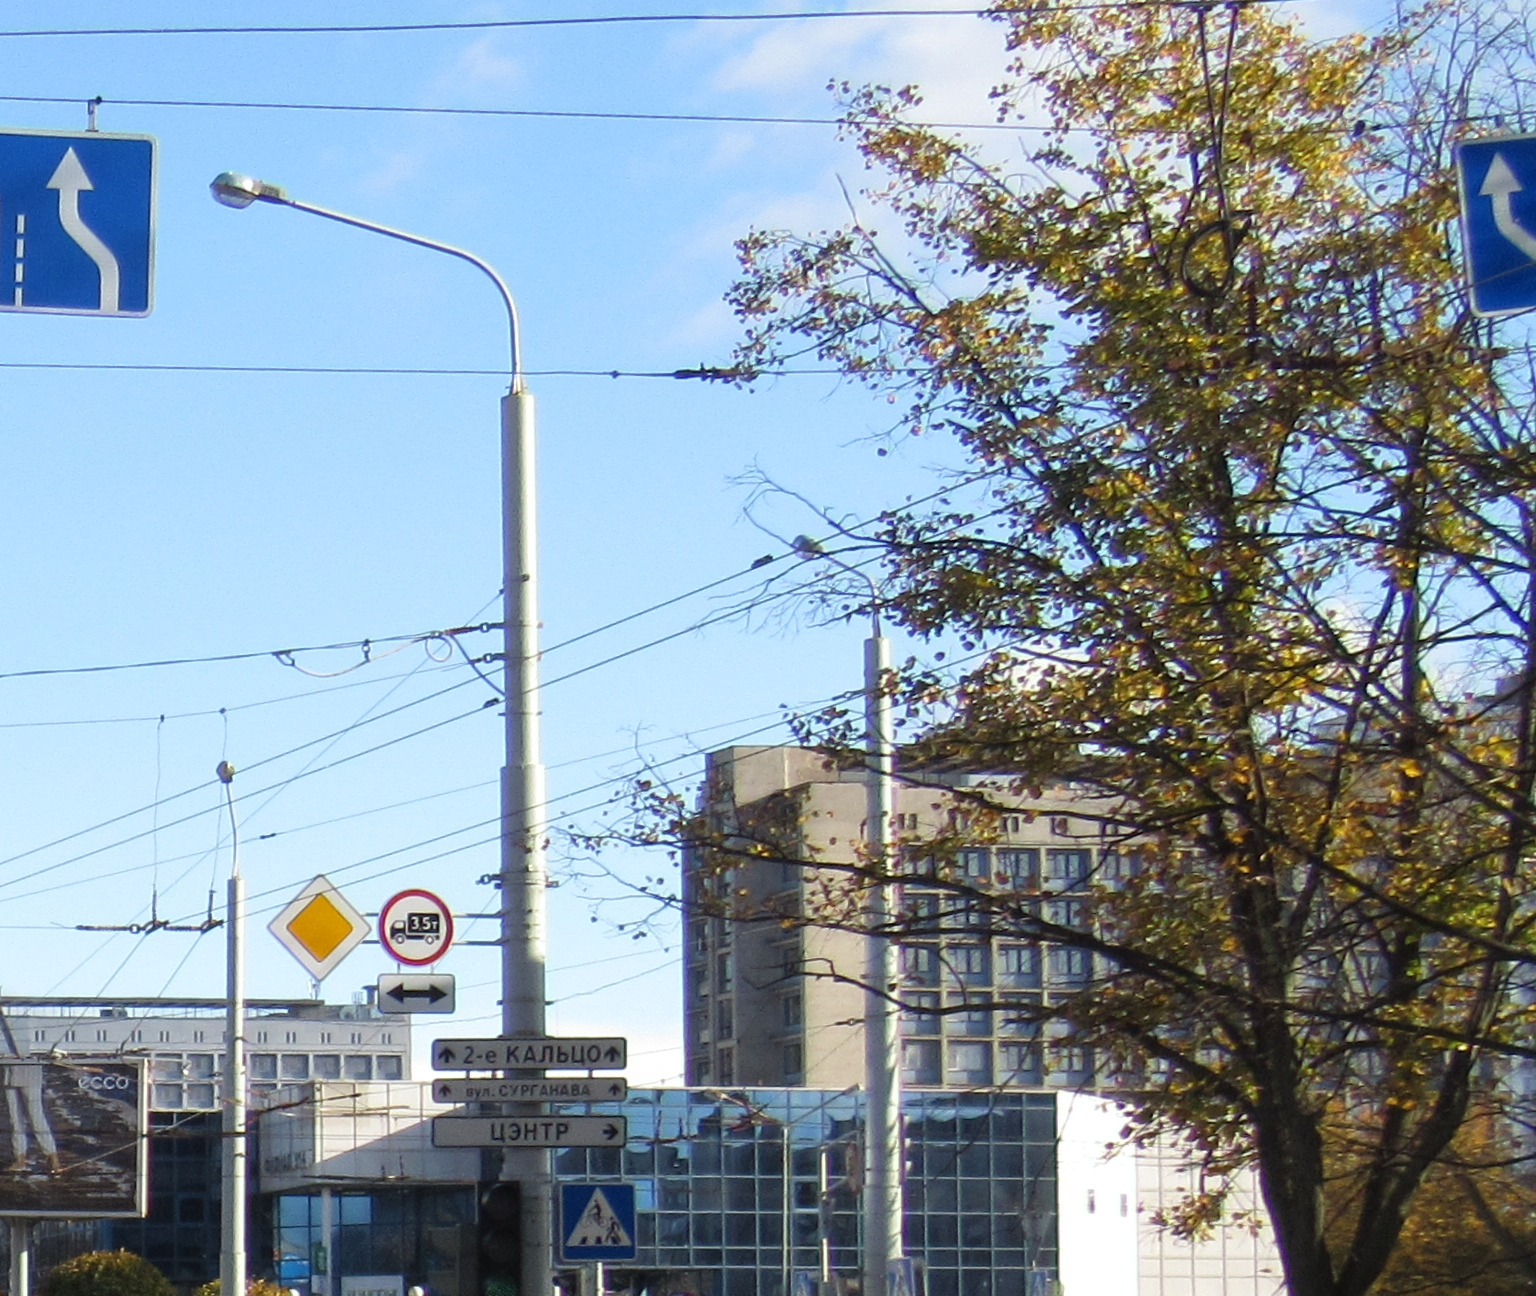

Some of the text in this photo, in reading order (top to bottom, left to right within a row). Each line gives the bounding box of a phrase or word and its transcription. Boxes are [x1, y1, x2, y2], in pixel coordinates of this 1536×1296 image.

[463, 1045, 601, 1065] 2-е КАЛЬЦО
[78, 1076, 129, 1090] ecco
[465, 1083, 591, 1100] вул. СУРГАНАВА
[490, 1123, 569, 1143] ЦЭНТР
